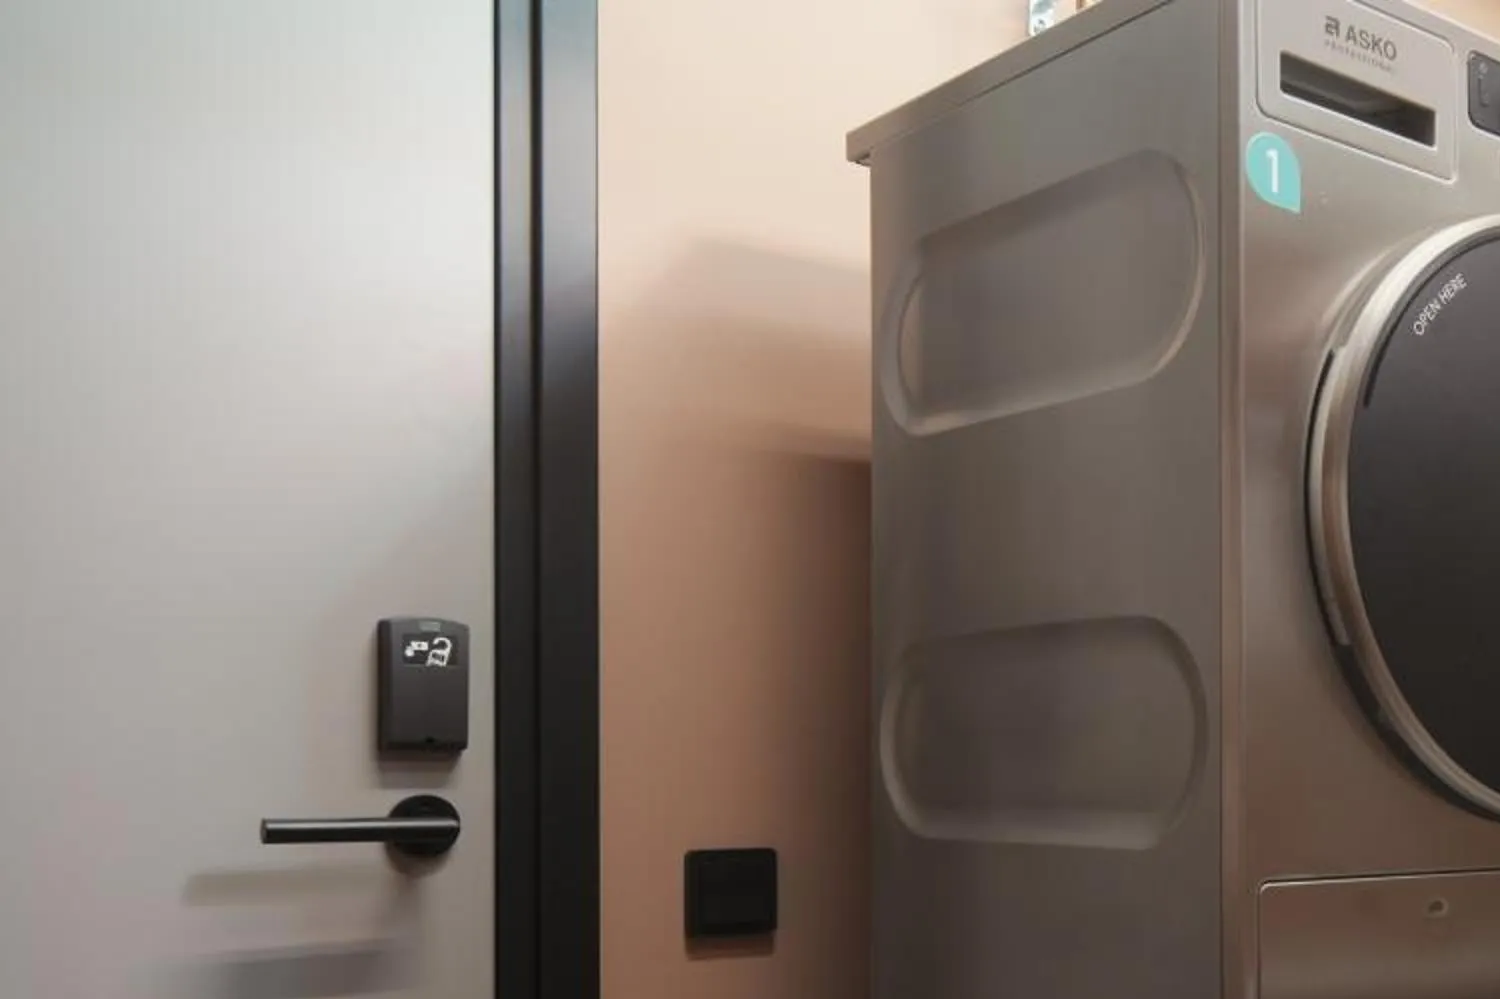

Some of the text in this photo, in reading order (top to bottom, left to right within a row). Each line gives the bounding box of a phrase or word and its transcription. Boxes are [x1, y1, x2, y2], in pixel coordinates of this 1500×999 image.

[1345, 25, 1397, 61] ASKO
[1266, 149, 1279, 193] 1
[1413, 272, 1467, 336] OPEN HERE
